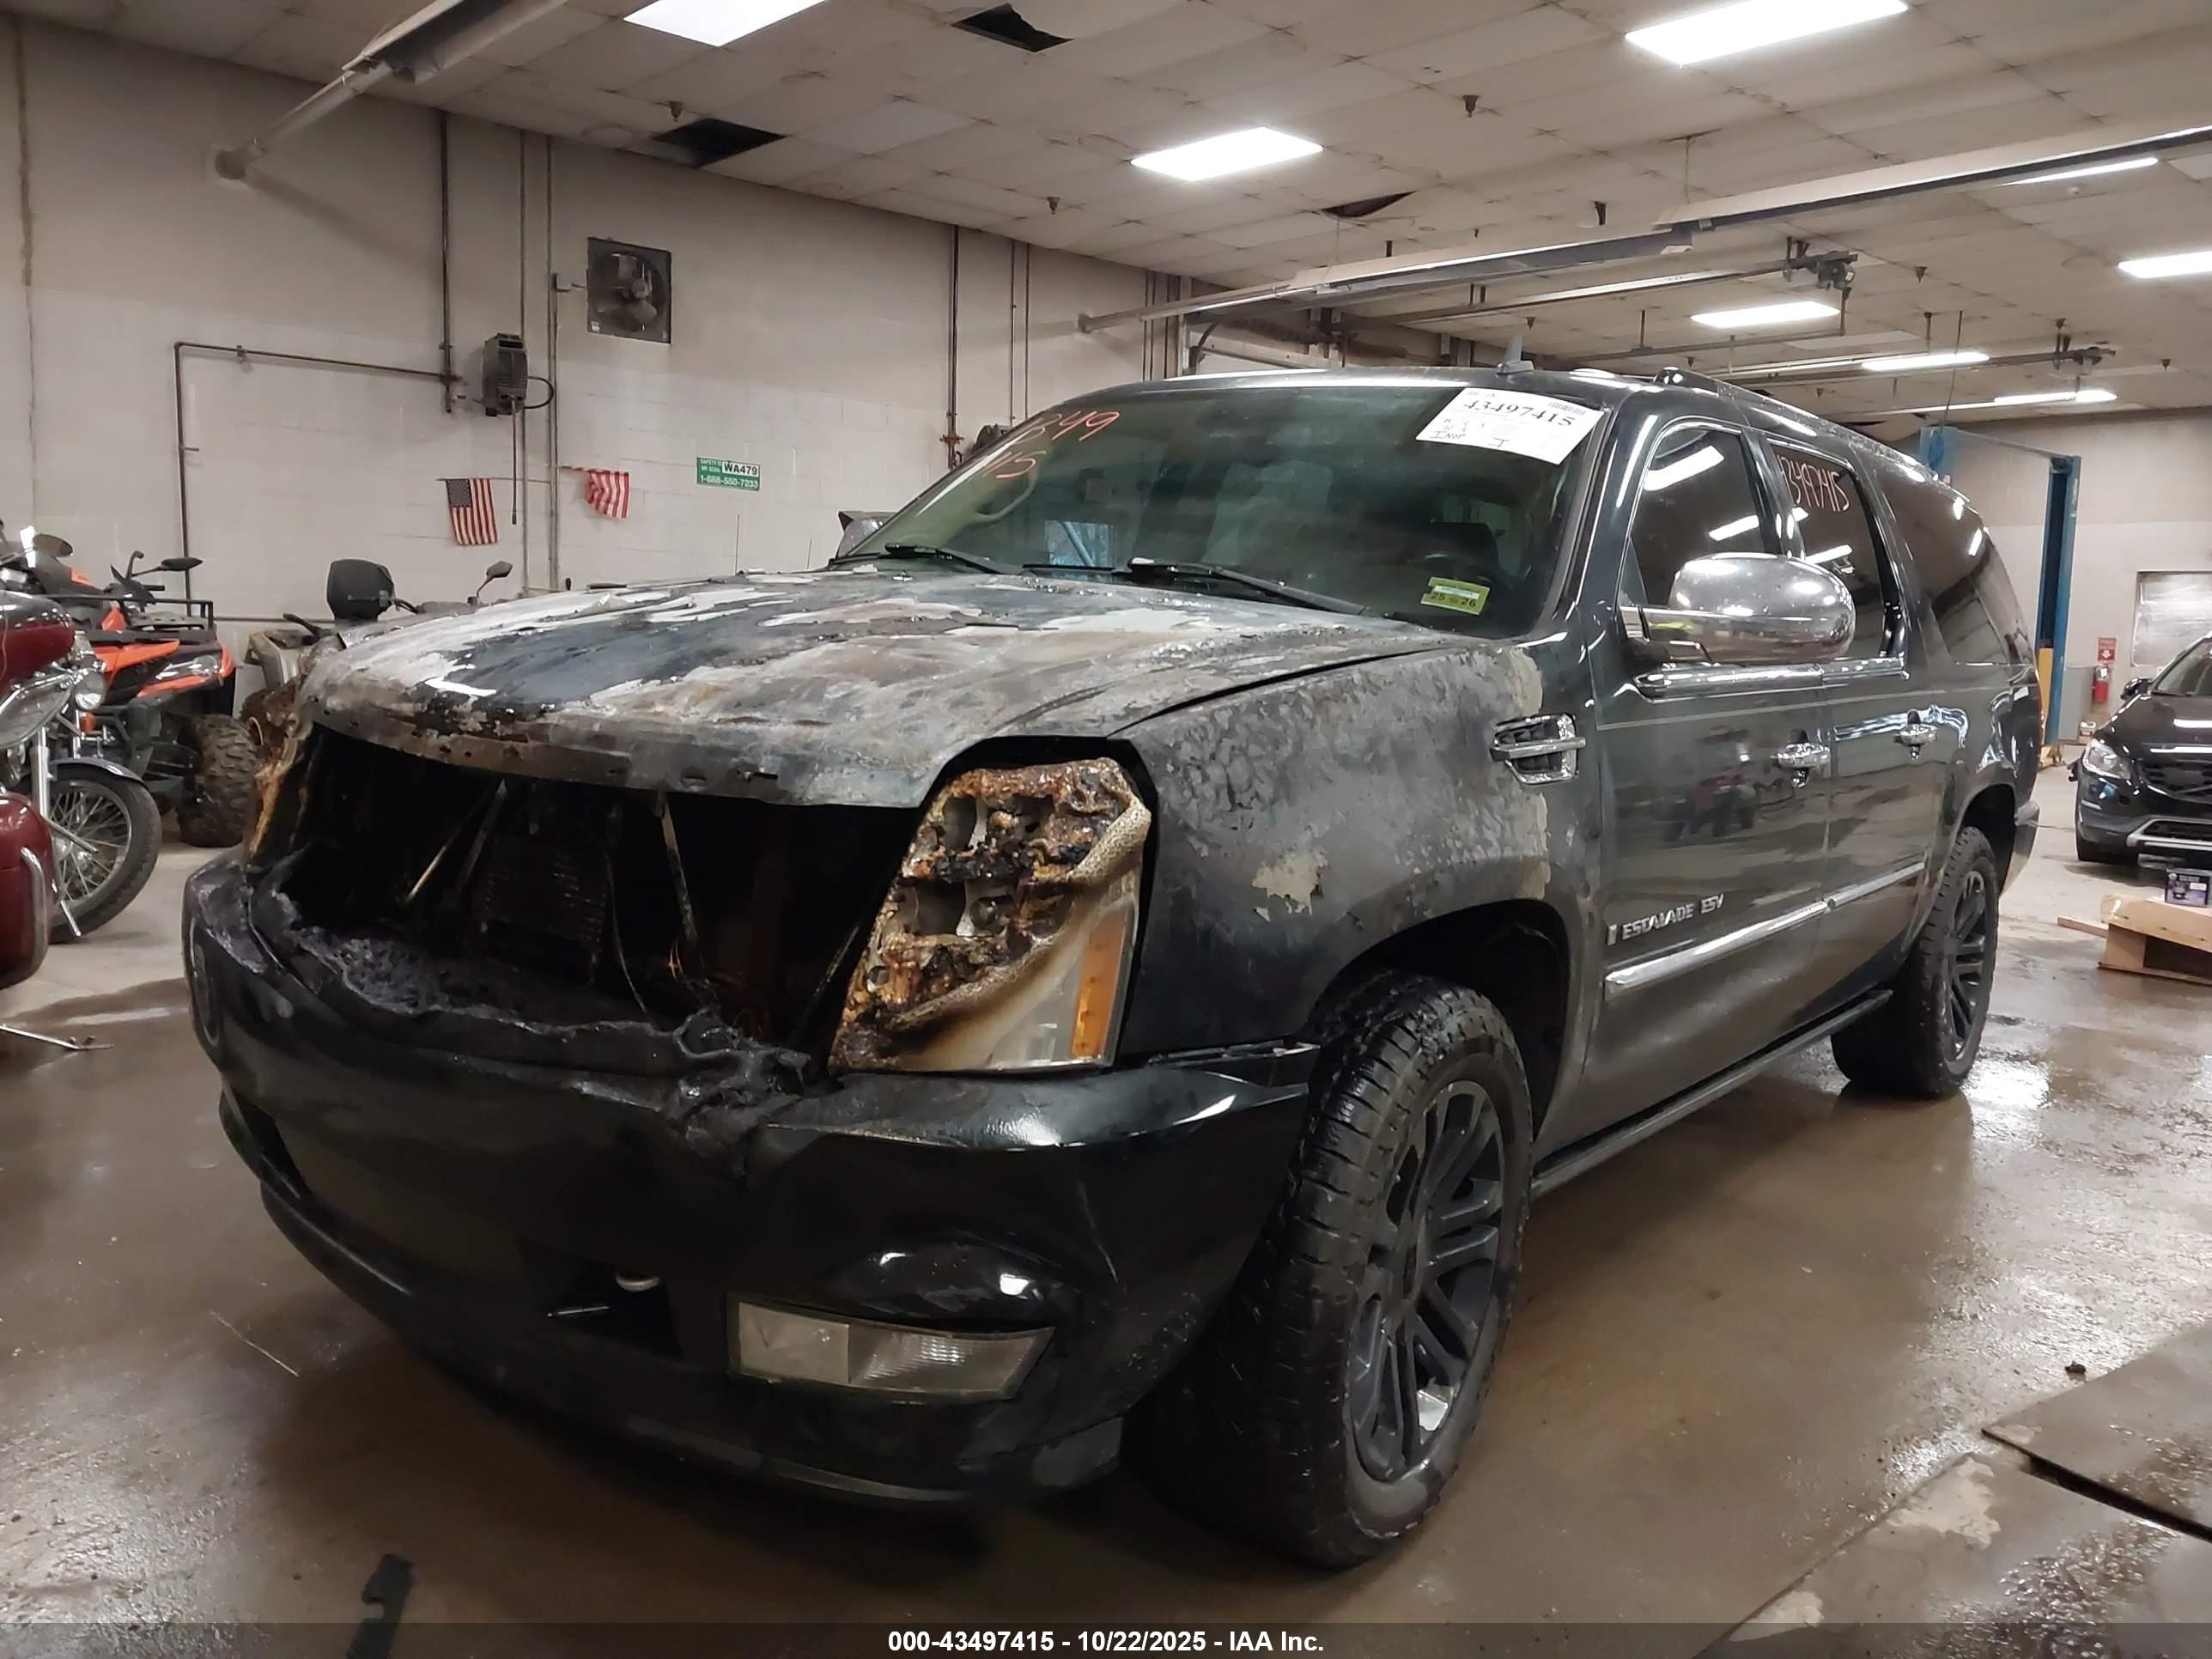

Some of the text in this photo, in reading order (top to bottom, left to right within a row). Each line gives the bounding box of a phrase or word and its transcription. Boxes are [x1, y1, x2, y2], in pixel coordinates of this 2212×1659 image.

[1463, 399, 1577, 428] 43497415
[724, 462, 757, 476] WA479
[1621, 893, 1724, 940] ESCALADE ESV
